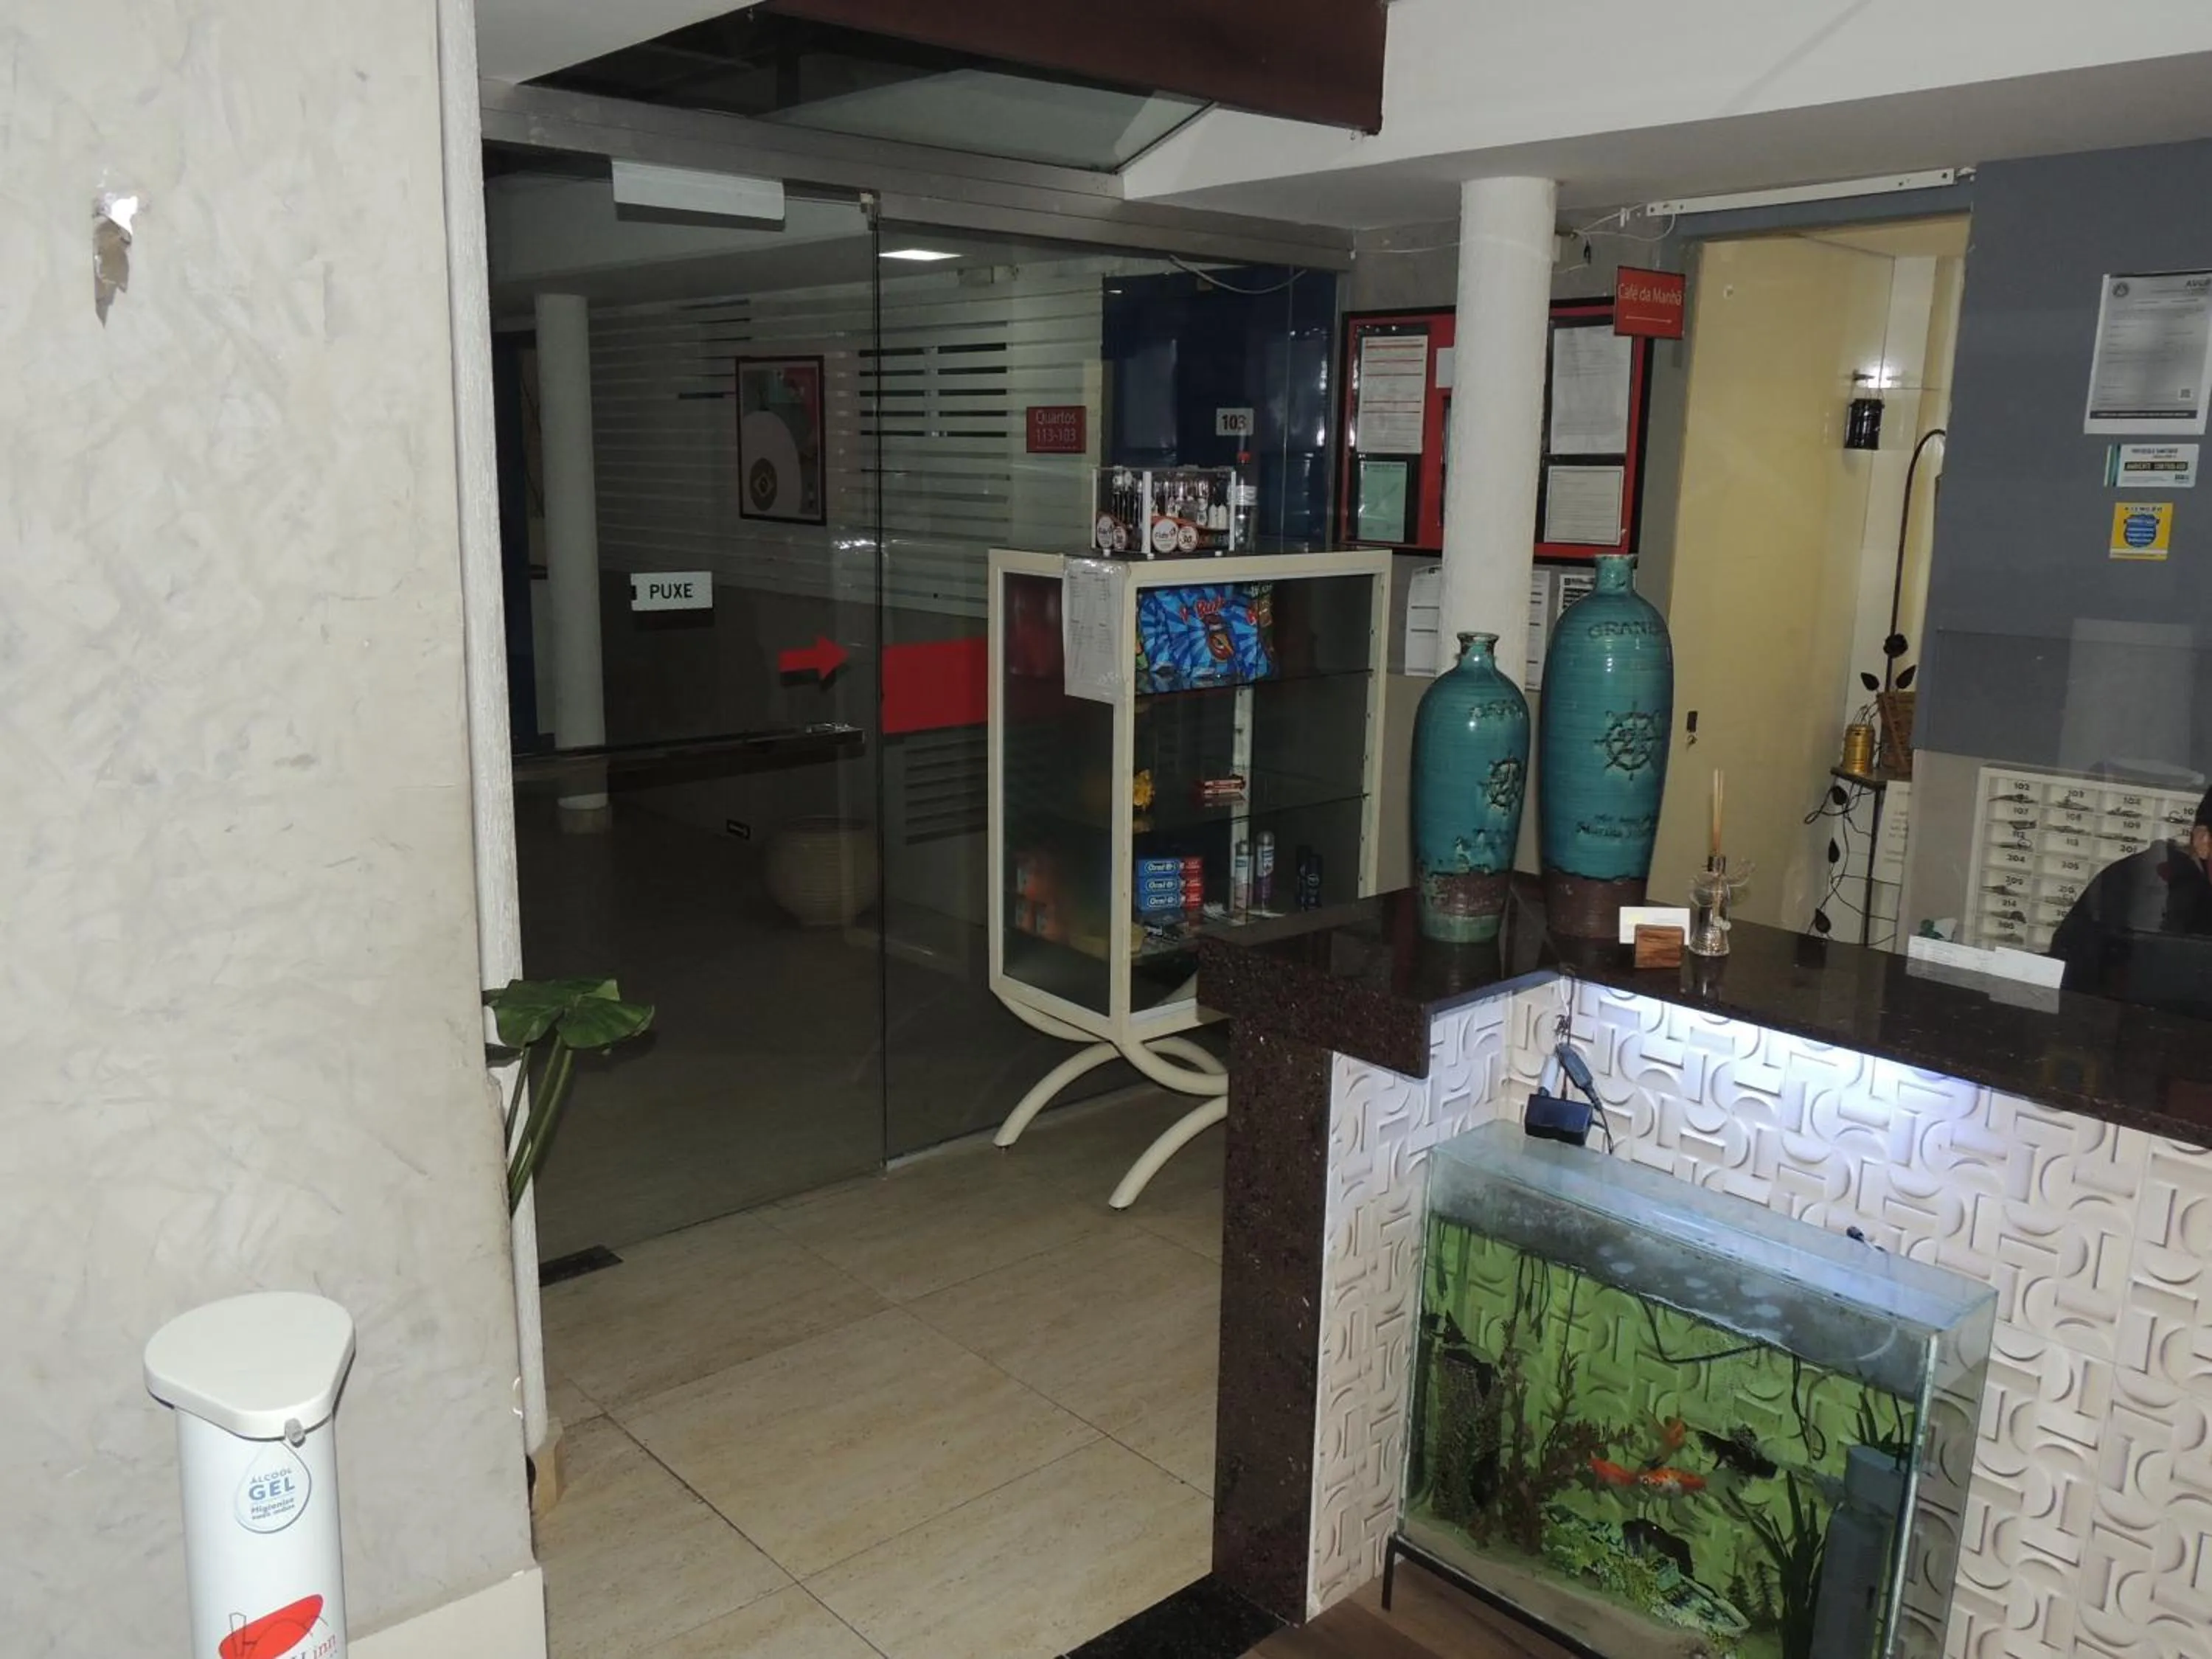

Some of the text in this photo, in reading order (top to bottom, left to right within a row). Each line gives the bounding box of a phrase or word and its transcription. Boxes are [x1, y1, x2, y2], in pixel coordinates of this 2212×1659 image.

[1618, 283, 1682, 305] Café da Manhã
[1035, 409, 1077, 425] Quartos
[1222, 414, 1247, 431] 103
[650, 582, 694, 599] PUXE
[2014, 782, 2031, 790] 102
[249, 1477, 296, 1500] GEL
